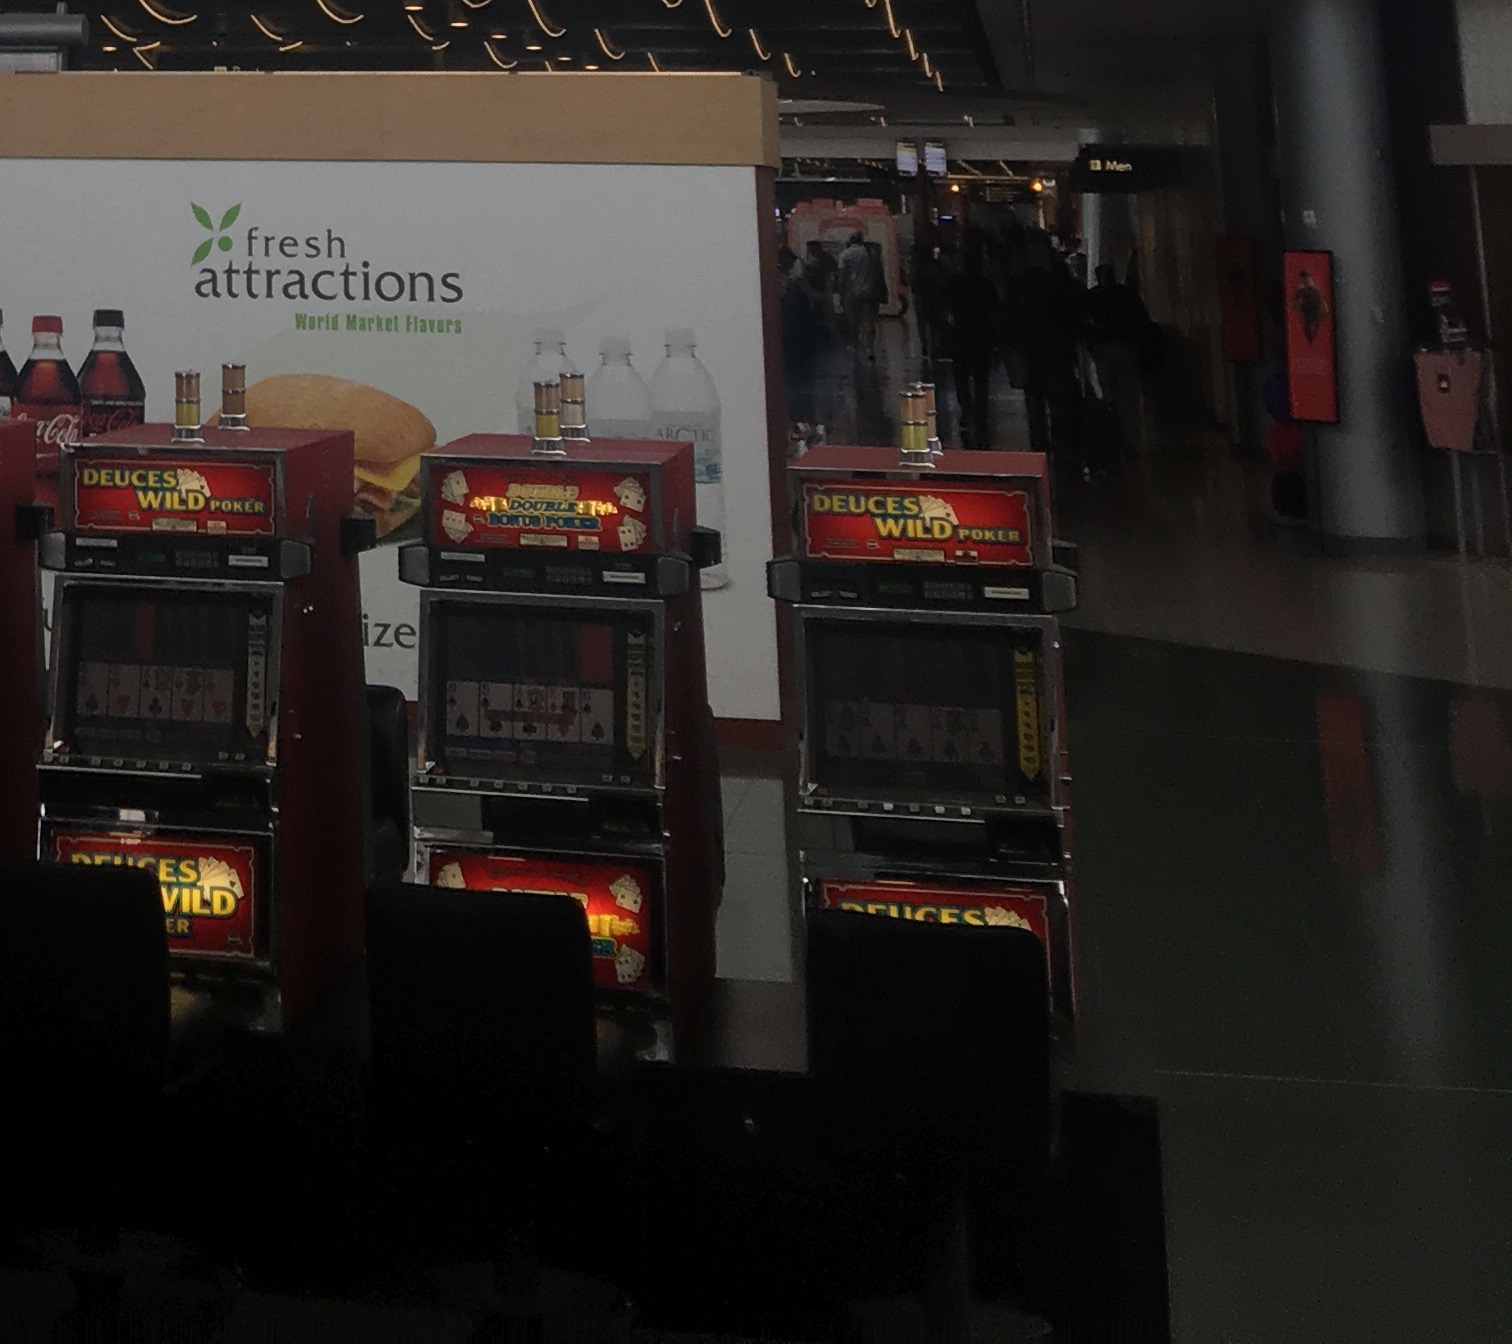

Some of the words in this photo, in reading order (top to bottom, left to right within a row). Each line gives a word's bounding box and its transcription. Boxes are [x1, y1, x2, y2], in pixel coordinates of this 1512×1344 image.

[1105, 159, 1133, 172] Men
[246, 226, 347, 259] fresh
[194, 260, 464, 303] attractions
[295, 312, 339, 331] World
[345, 314, 400, 333] Market
[405, 316, 463, 334] Flavors
[82, 468, 177, 488] DEUCES
[136, 489, 206, 511] WILD
[209, 500, 265, 513] POKER
[508, 498, 579, 513] DOUBLE
[812, 494, 920, 515] DEUCES
[874, 516, 955, 541] WILD
[957, 527, 1022, 543] POKER
